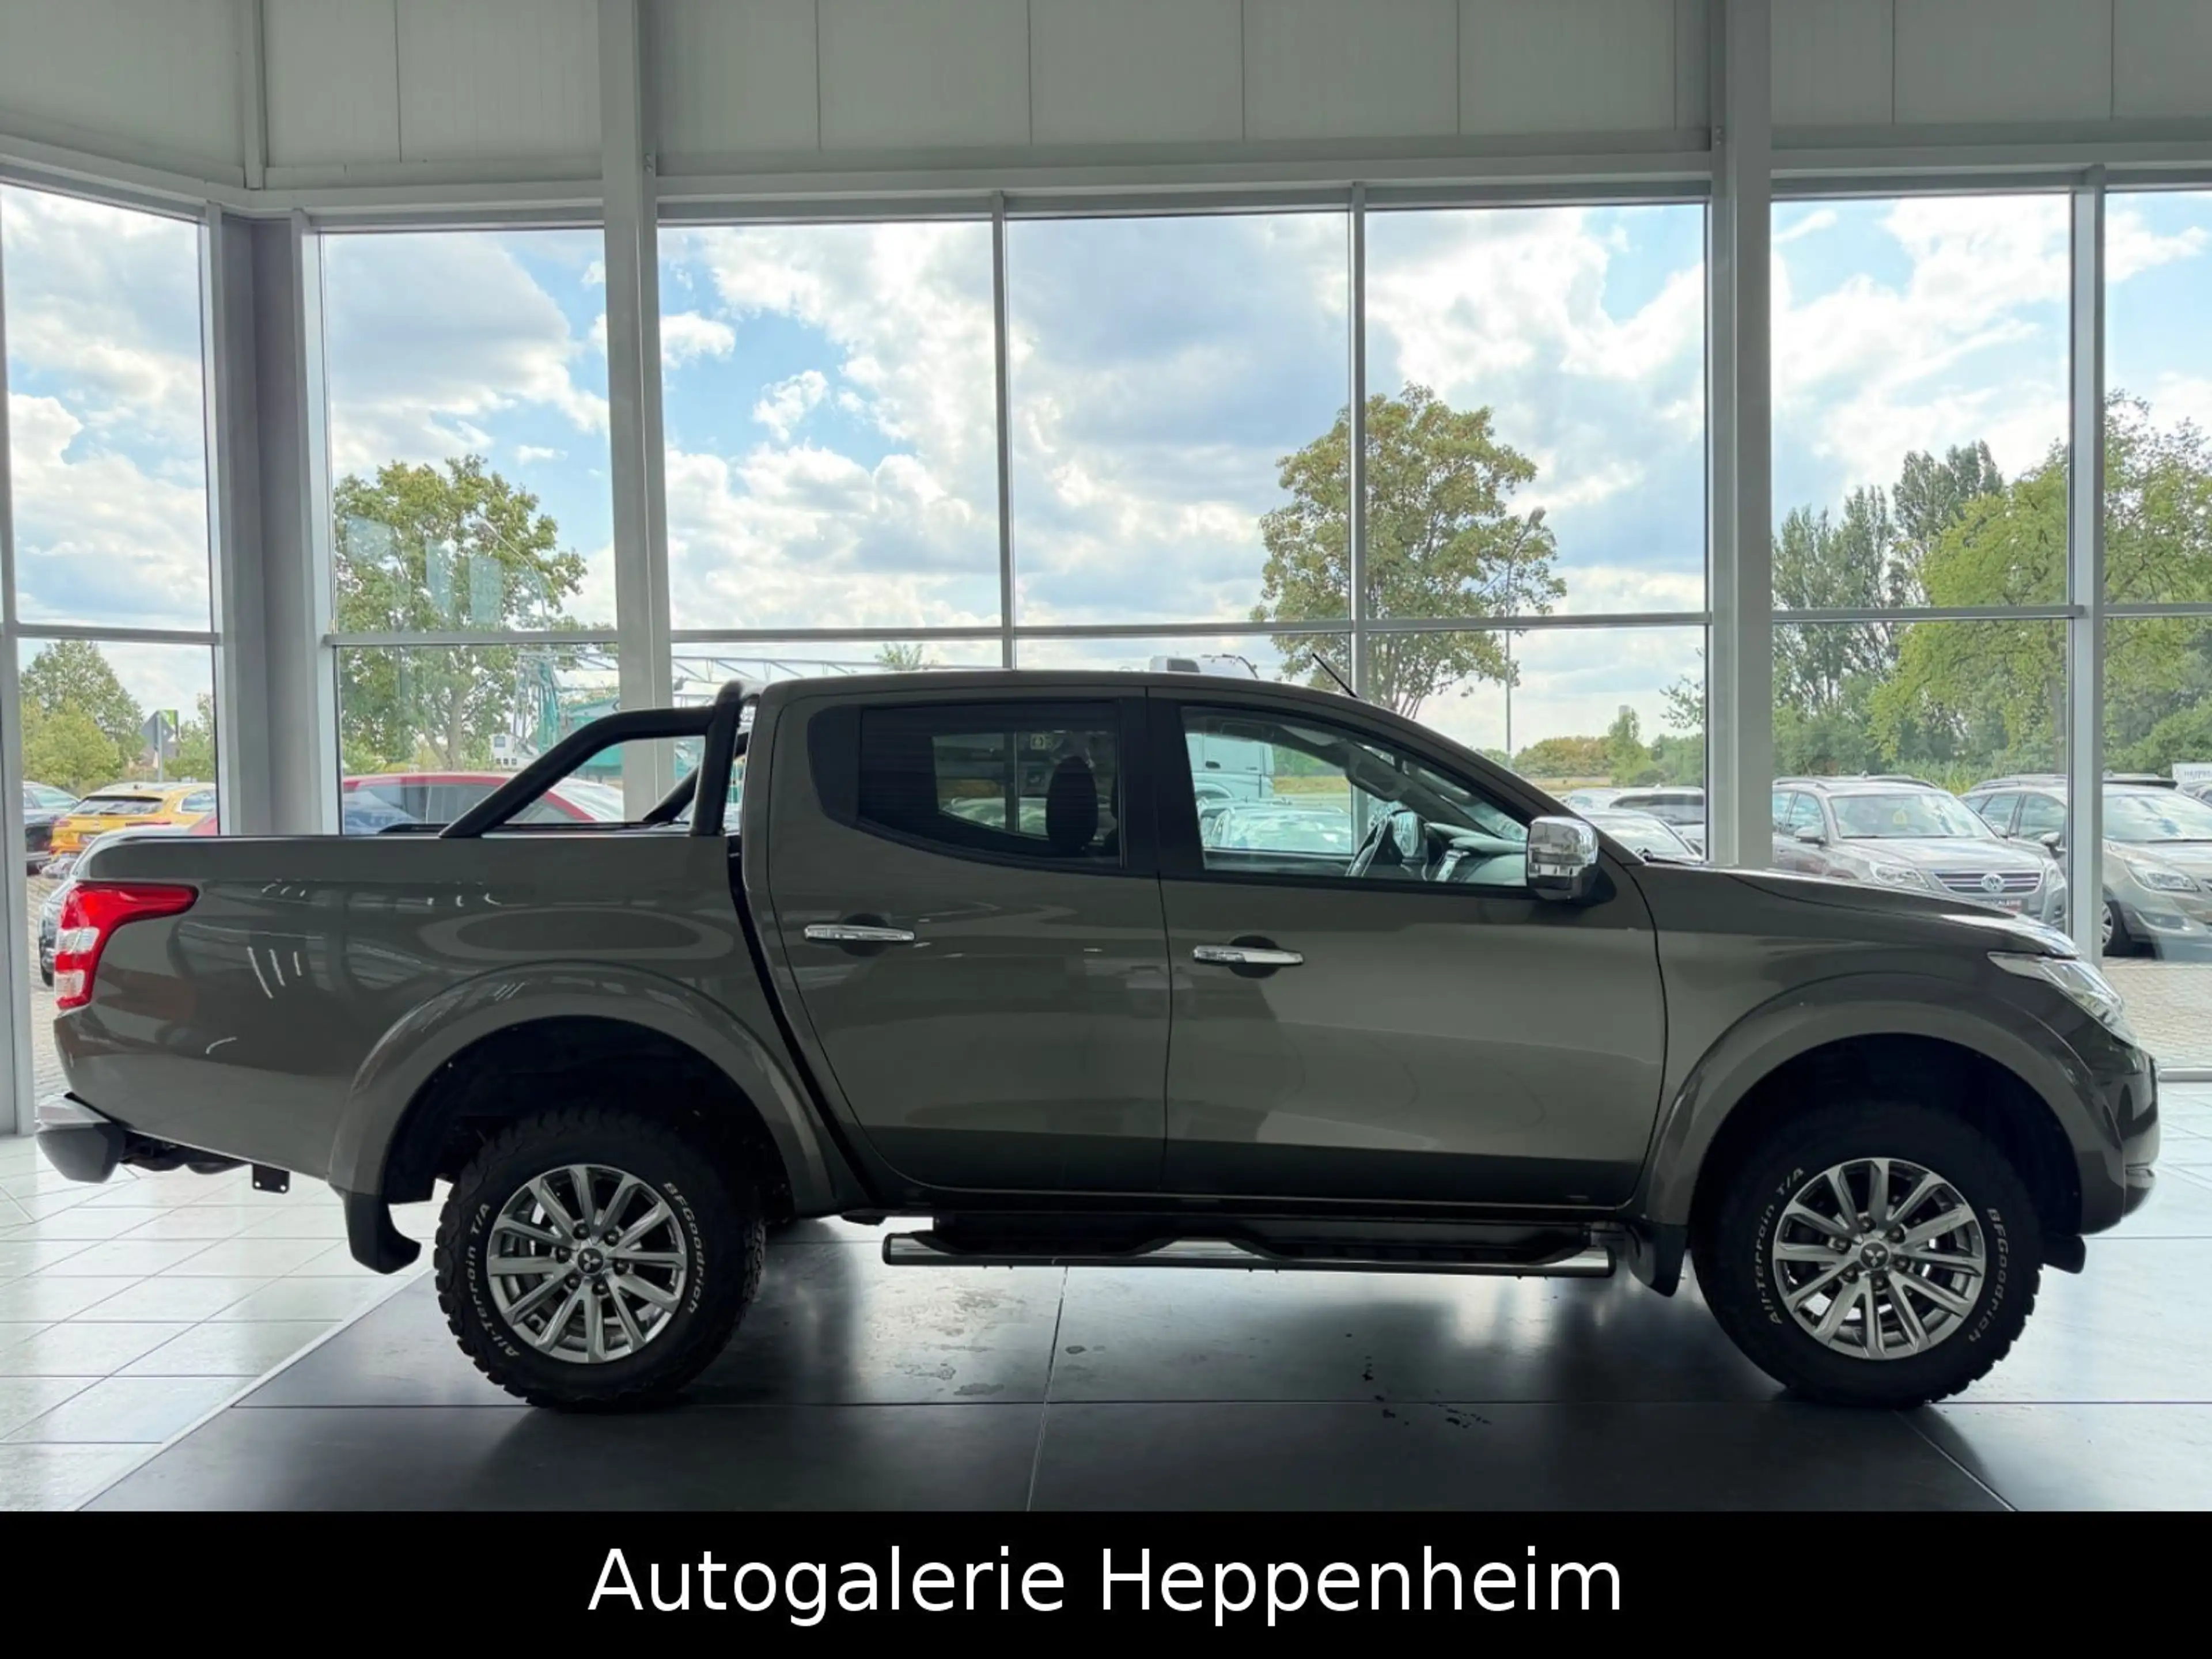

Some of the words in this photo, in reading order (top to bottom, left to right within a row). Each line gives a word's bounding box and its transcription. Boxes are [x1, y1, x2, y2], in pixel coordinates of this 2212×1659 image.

[470, 1202, 490, 1235] T/A
[1776, 1168, 1804, 1196] T/A
[664, 1182, 706, 1314] BFGoodrich
[1968, 1208, 2009, 1343] BFGoodrich
